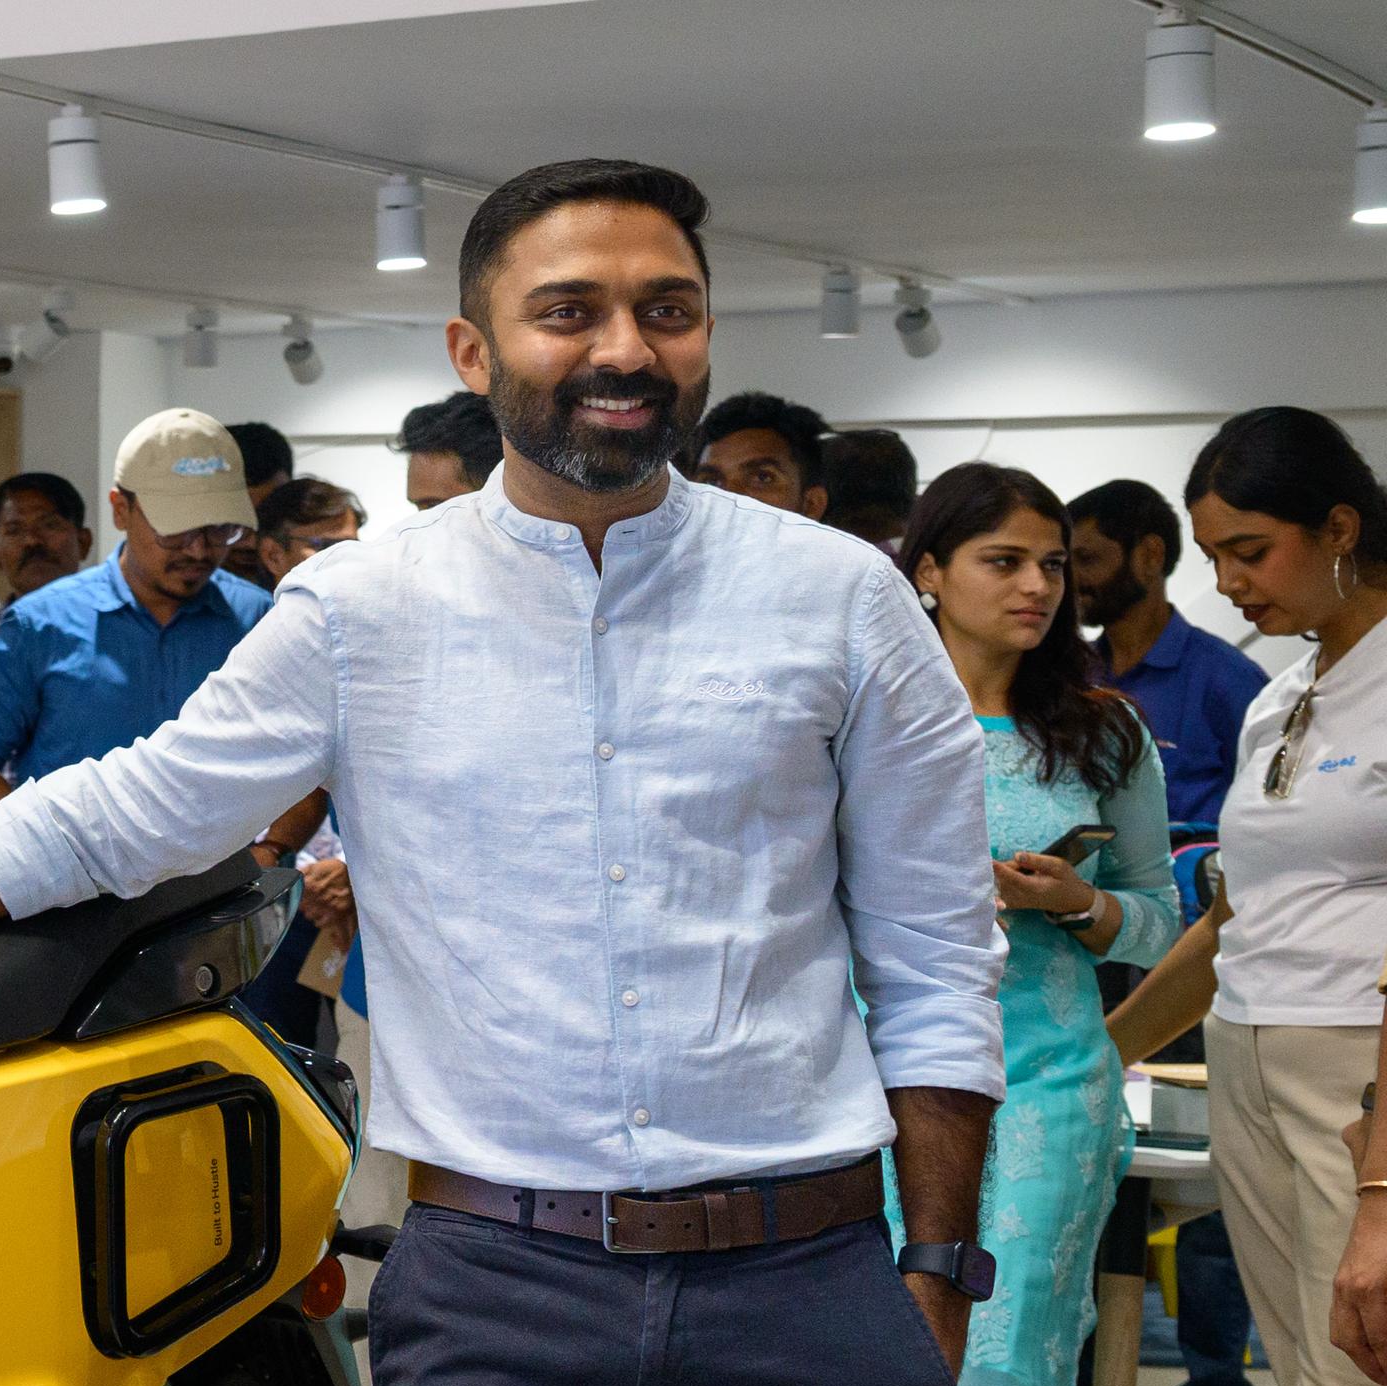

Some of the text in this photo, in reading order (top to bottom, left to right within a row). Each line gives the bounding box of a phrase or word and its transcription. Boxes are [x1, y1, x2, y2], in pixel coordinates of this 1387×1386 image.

[210, 1158, 223, 1247] Built to Hustle
